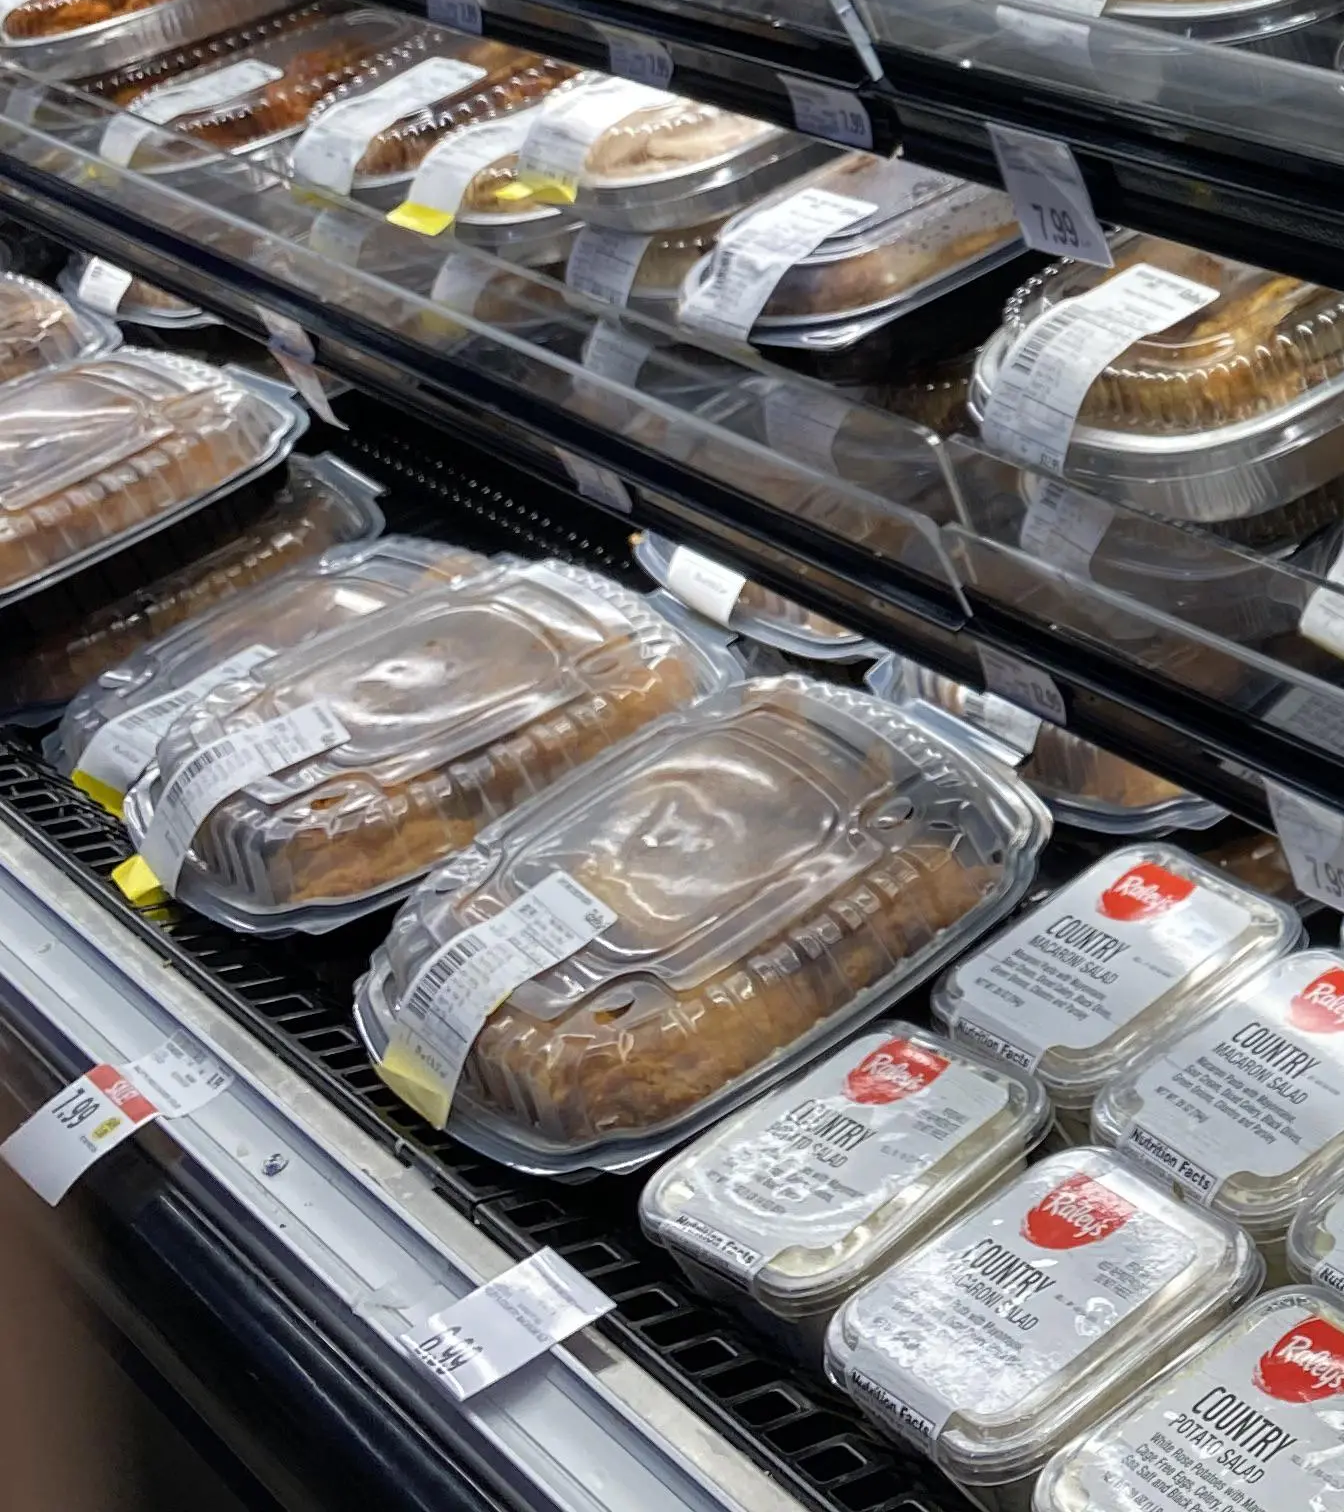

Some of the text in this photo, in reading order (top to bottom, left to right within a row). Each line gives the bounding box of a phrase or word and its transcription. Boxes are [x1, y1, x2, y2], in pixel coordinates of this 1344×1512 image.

[1031, 203, 1076, 248] 7.99
[1044, 914, 1132, 964] COUNTRY
[1231, 1022, 1323, 1080] COUNTRY
[1191, 1386, 1300, 1463] COUNTRY
